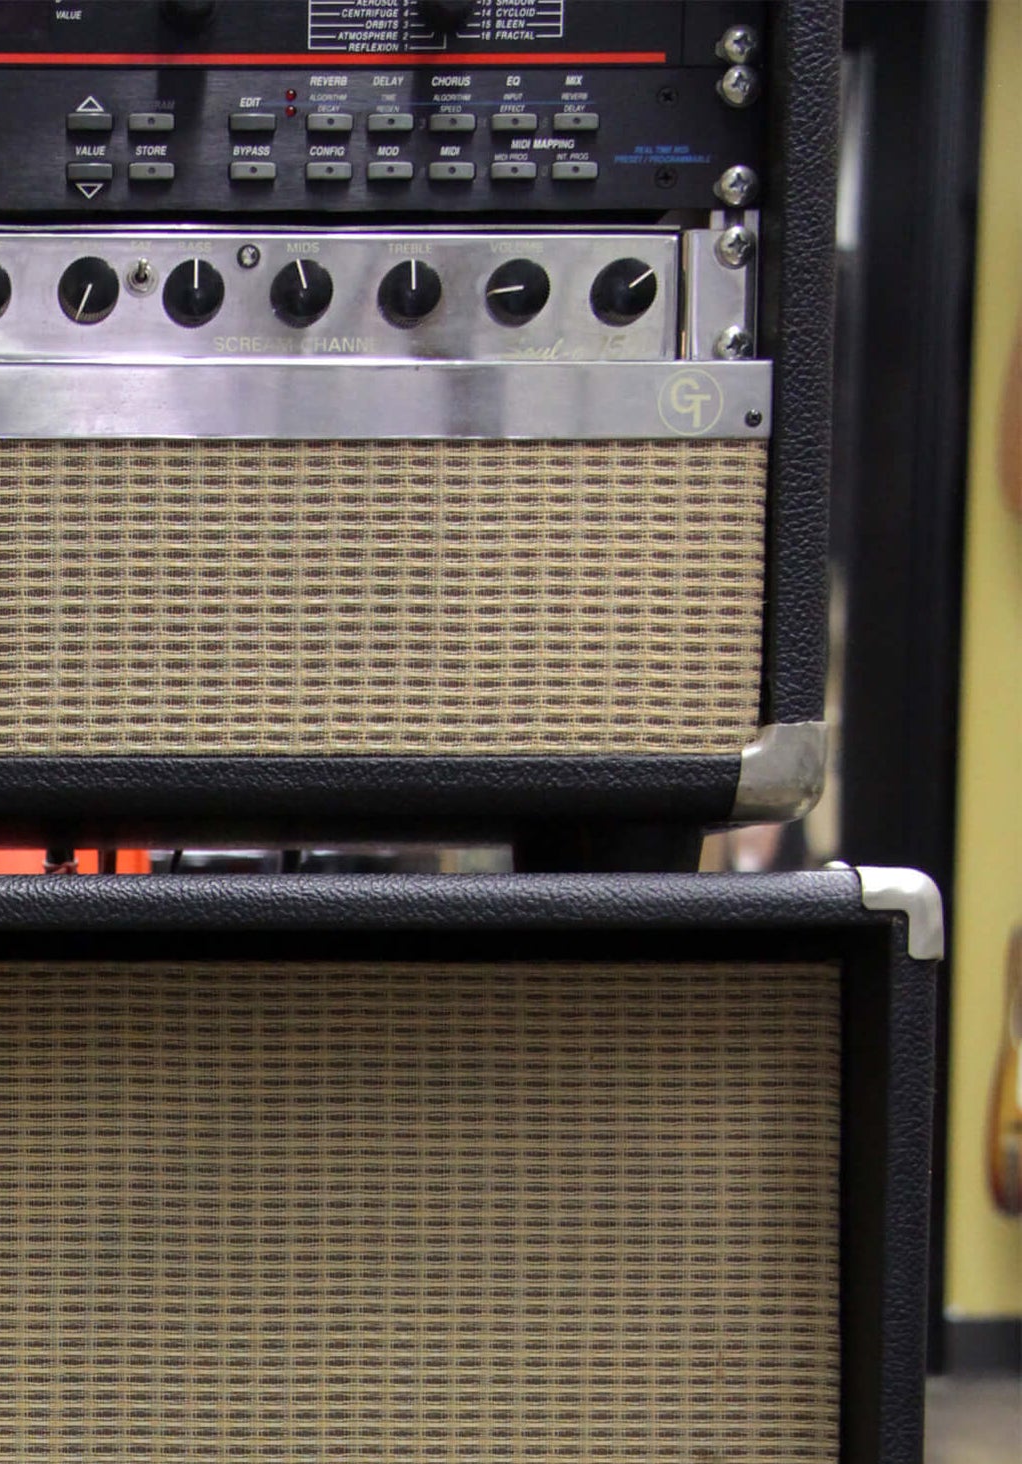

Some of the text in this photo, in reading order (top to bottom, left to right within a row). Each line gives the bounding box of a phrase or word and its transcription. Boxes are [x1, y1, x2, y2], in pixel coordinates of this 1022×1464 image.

[56, 10, 83, 21] VALUE
[341, 8, 409, 17] CENTRIFUGE 4
[481, 8, 536, 17] 14 CYCLOID
[365, 20, 409, 29] ORBITS 3
[481, 20, 526, 29] 15 BLEEN
[338, 31, 409, 41] ATMOSPHERE 2
[481, 31, 535, 40] 16 FRACTAL
[348, 42, 399, 52] REFLEXION
[309, 76, 348, 87] REVERB
[373, 76, 404, 87] DELAY
[431, 76, 471, 87] CHORUS
[506, 76, 521, 87] EQ
[565, 75, 583, 86] MIX
[239, 97, 261, 108] EDIT
[439, 105, 462, 113] SPEED
[500, 105, 525, 113] EFFECT
[563, 104, 586, 113] DELAY
[511, 138, 575, 150] MIDI MAPPING
[75, 145, 106, 156] VALUE
[135, 145, 168, 156] STORE
[233, 146, 270, 157] BYPASS
[309, 146, 346, 157] CONFIG
[377, 146, 400, 157] MOD
[440, 146, 460, 156] MIDI
[509, 153, 529, 161] PROG
[287, 242, 321, 254] MIDS
[388, 243, 433, 254] TREBLE
